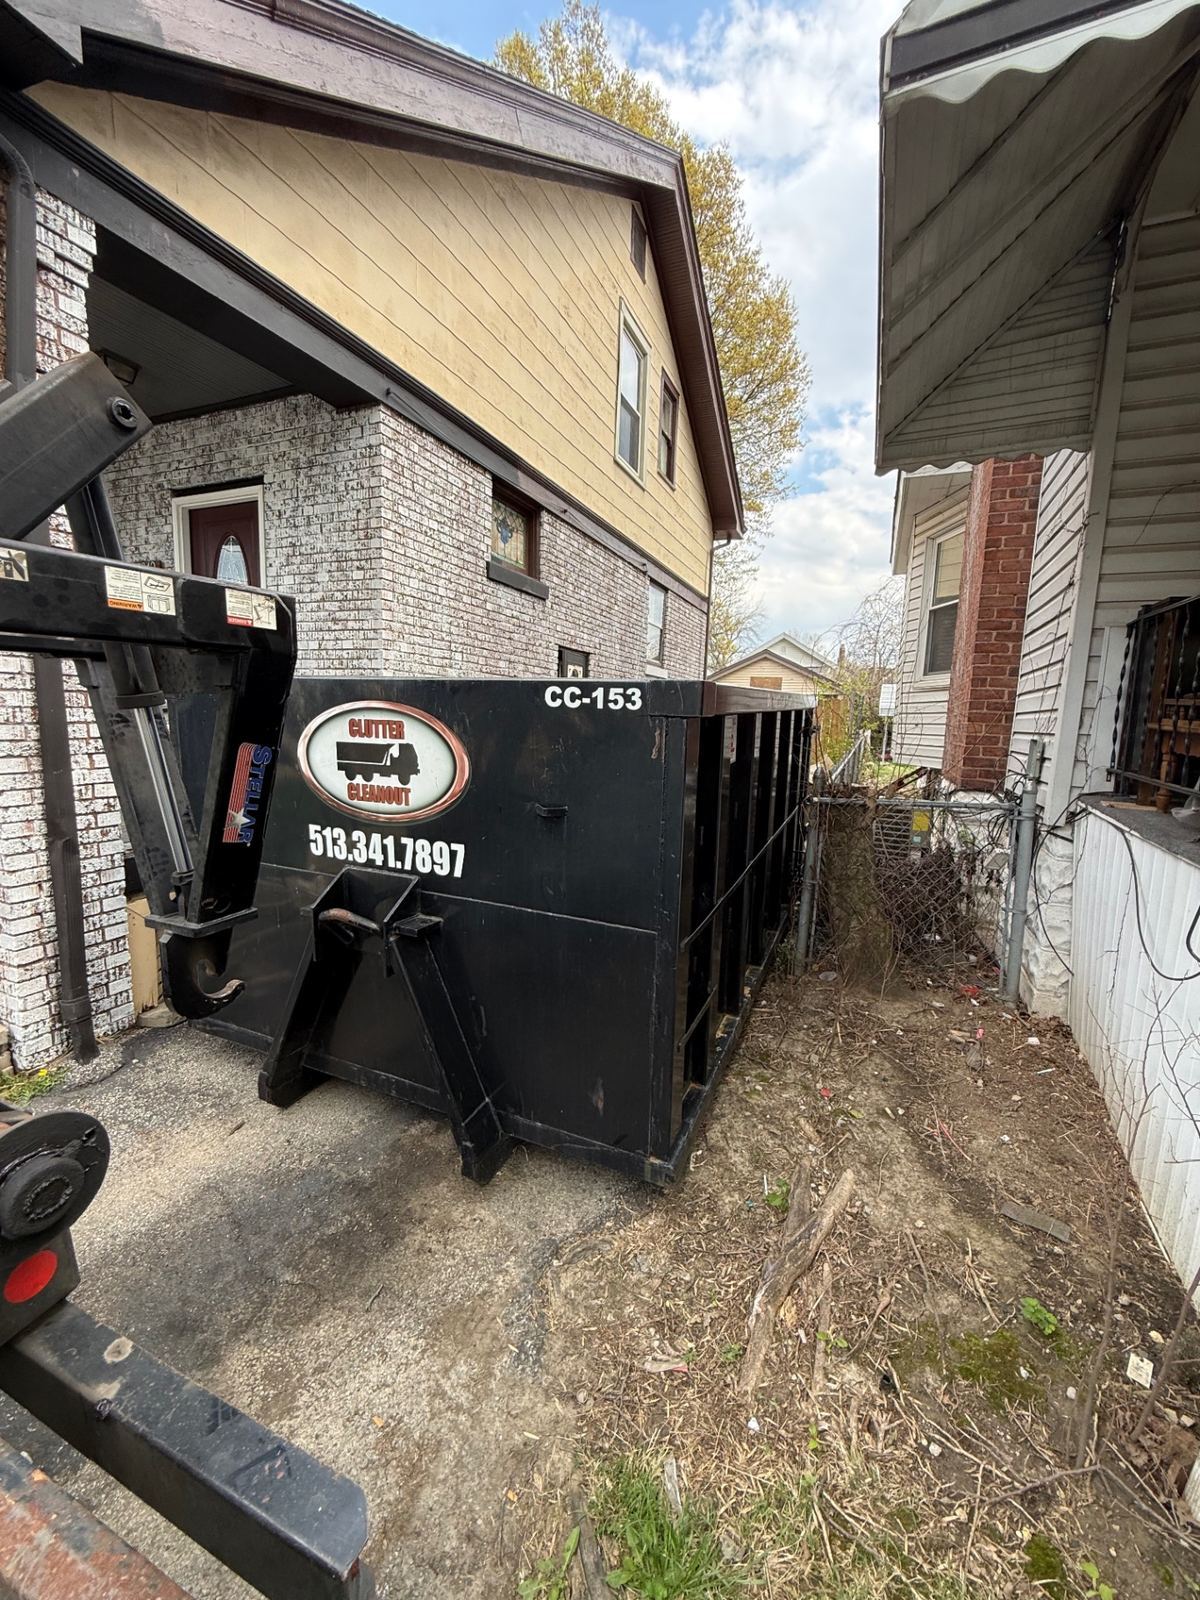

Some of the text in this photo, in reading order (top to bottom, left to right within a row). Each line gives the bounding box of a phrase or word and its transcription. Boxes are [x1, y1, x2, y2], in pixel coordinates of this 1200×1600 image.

[544, 686, 643, 711] CC-153
[348, 718, 405, 740] CLUTTER
[237, 745, 273, 843] STELLAR
[347, 782, 411, 806] CLEANOUT
[308, 824, 465, 878] 513.341.7897
